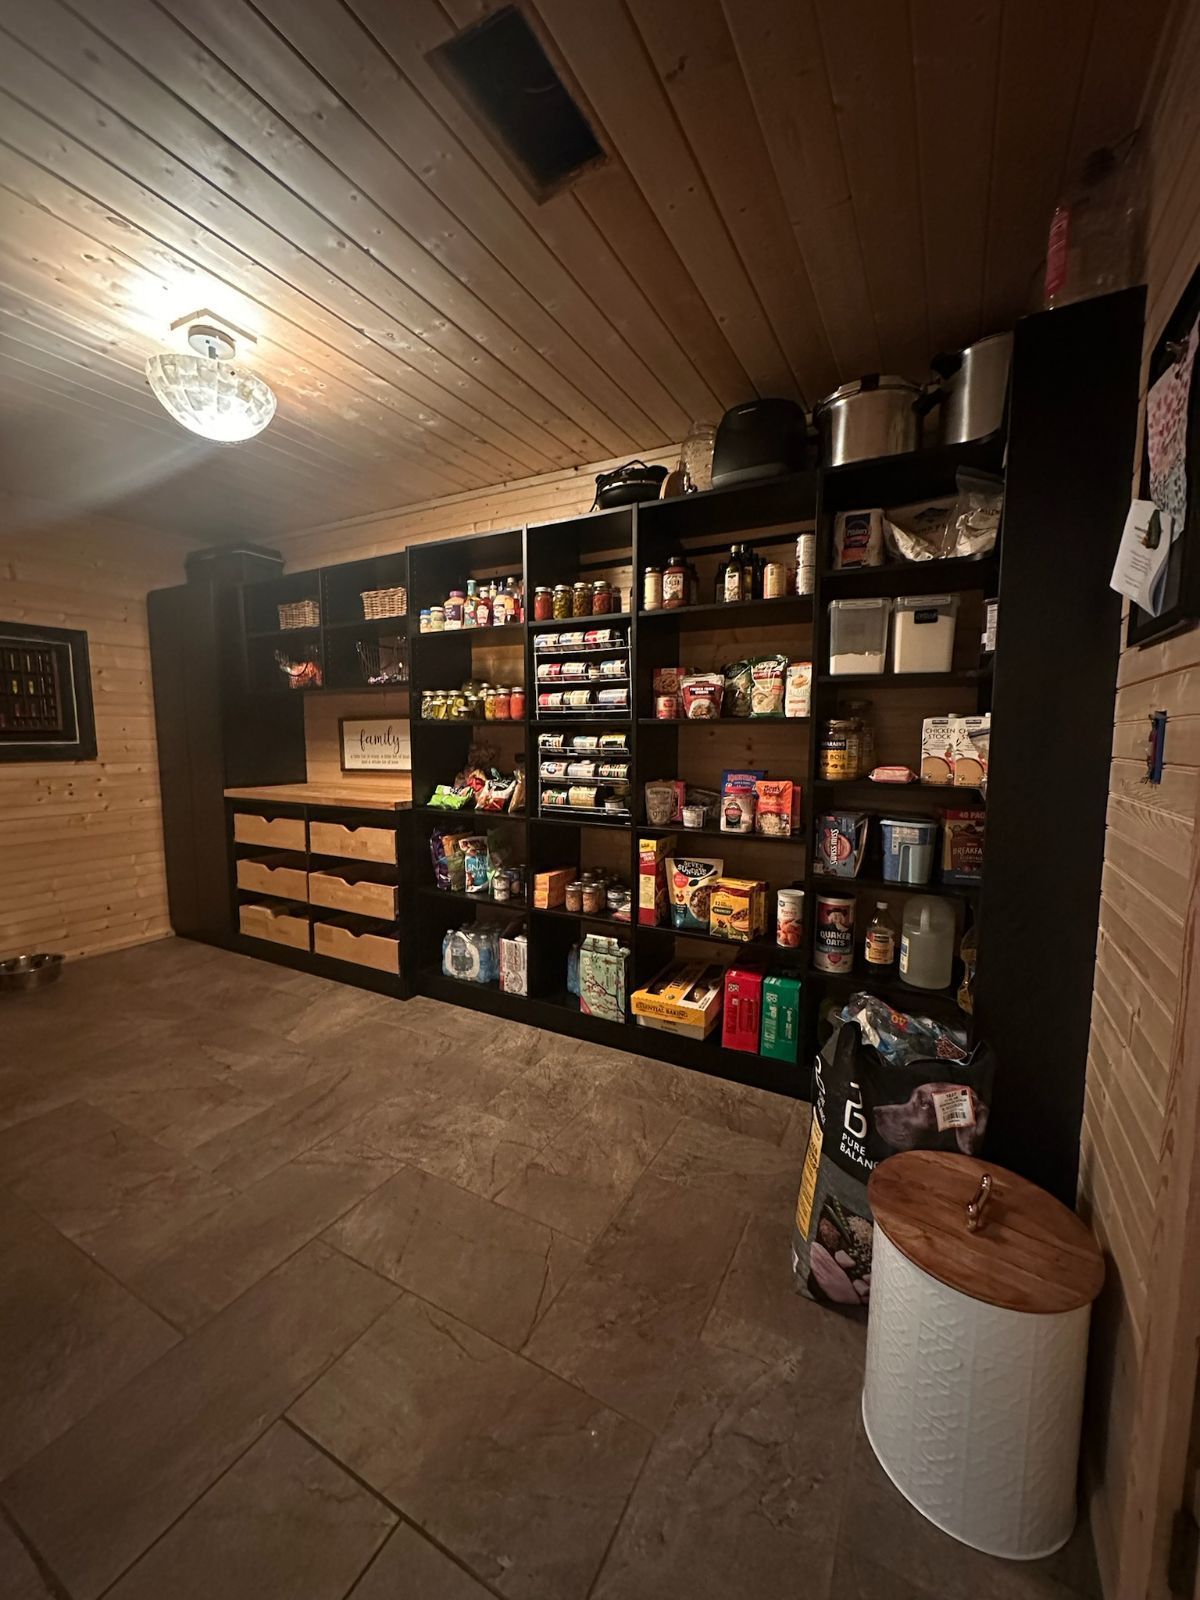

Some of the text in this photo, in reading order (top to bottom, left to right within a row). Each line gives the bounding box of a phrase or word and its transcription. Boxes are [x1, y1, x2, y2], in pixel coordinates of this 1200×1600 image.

[360, 725, 400, 755] family
[959, 811, 985, 819] 40 PAC
[829, 828, 839, 846] MISS
[829, 845, 838, 865] SWISS
[952, 847, 983, 855] BREAKFA
[677, 864, 707, 876] SUNDAYS
[683, 860, 704, 869] SEVEN
[819, 930, 852, 941] QUAKER
[825, 938, 846, 947] OATS
[841, 1133, 867, 1157] PURE
[839, 1142, 880, 1172] BALANC
